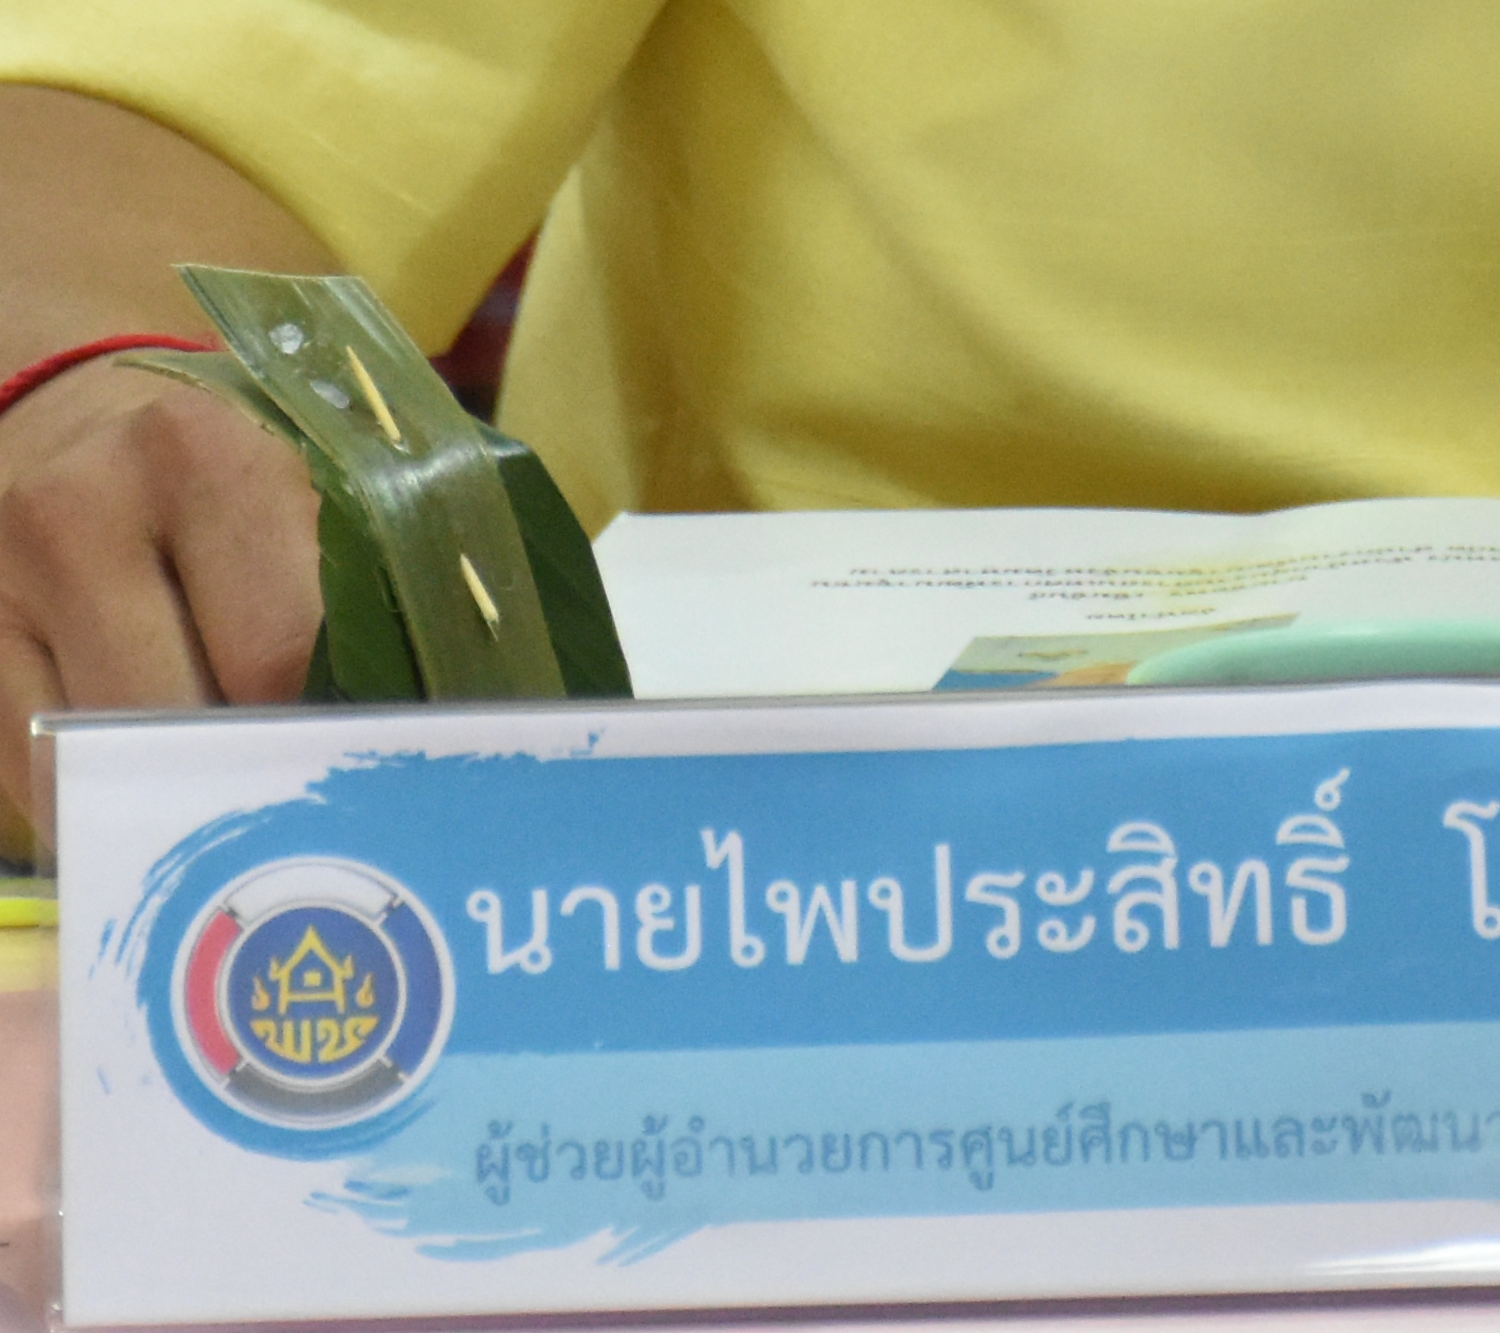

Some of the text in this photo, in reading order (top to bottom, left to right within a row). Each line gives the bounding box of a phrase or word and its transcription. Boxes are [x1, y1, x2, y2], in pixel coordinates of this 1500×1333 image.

[465, 766, 1351, 975] นายไพประสิทธิ์
